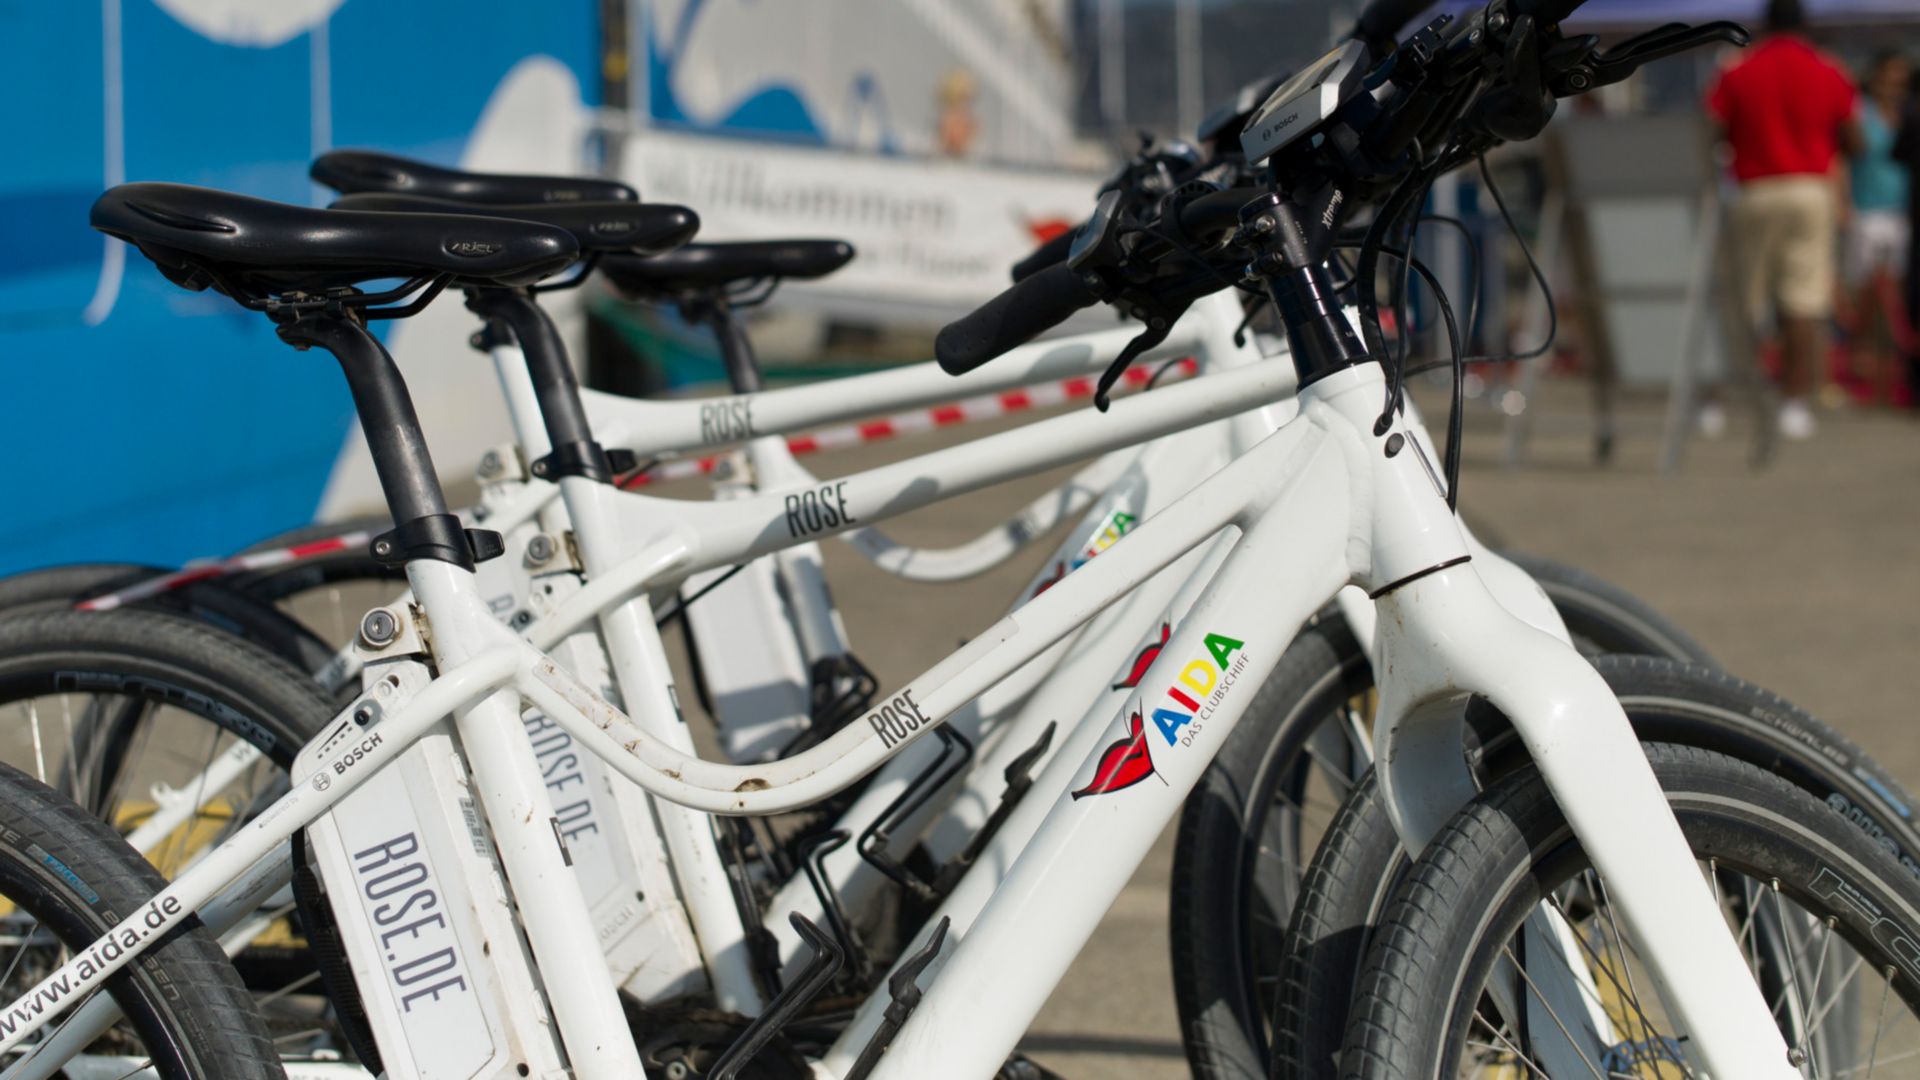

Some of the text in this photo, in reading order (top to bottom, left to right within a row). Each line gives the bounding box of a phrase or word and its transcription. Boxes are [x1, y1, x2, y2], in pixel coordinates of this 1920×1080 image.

[1274, 113, 1299, 132] BOSCH
[702, 401, 755, 446] ROSE
[785, 481, 856, 538] ROSE
[867, 688, 931, 749] ROSE
[1151, 632, 1245, 747] AIDA
[1181, 653, 1250, 748] DAS CLUBSCHIFF
[333, 732, 383, 775] BOSCH
[354, 831, 467, 1013] ROSE.DE
[0, 895, 182, 1040] www.aida.de
